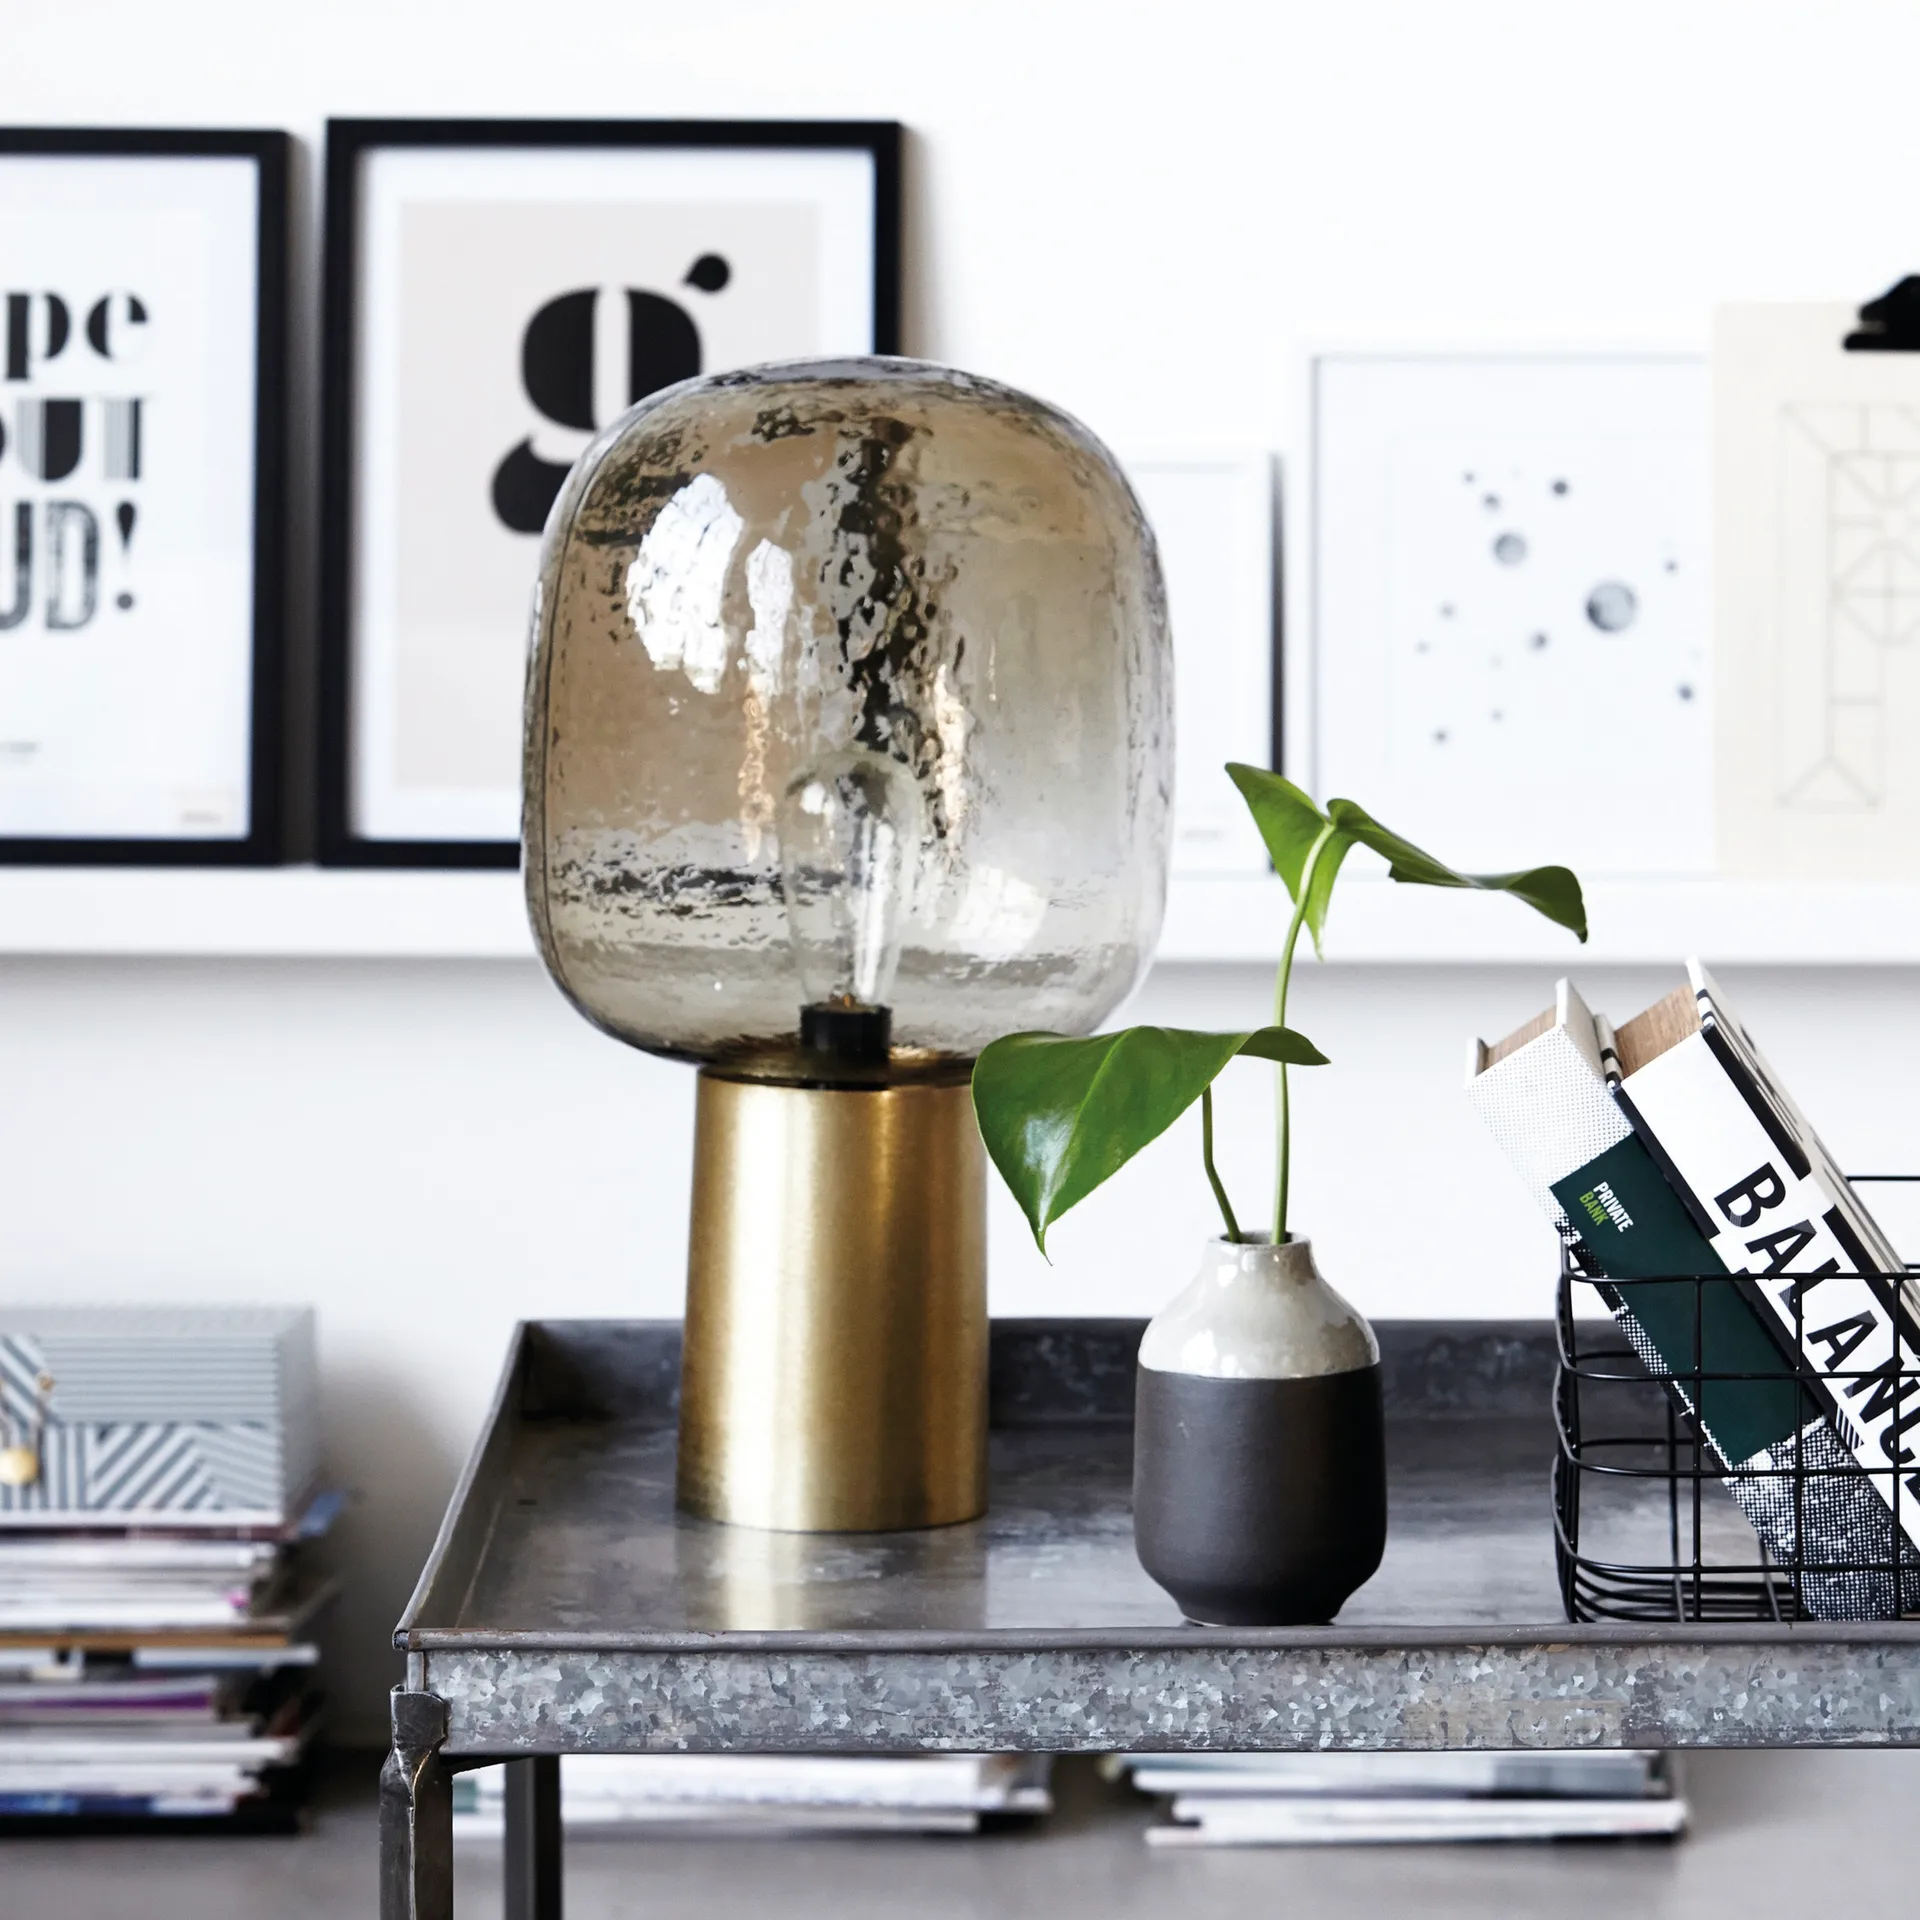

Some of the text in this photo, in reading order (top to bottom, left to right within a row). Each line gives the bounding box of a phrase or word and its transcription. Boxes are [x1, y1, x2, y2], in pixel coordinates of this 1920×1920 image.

[6, 290, 149, 381] pe
[0, 396, 152, 483] UT
[1579, 1190, 1609, 1227] BANK
[1592, 1180, 1635, 1233] PRIVATE
[1713, 1161, 1920, 1506] BALANC
